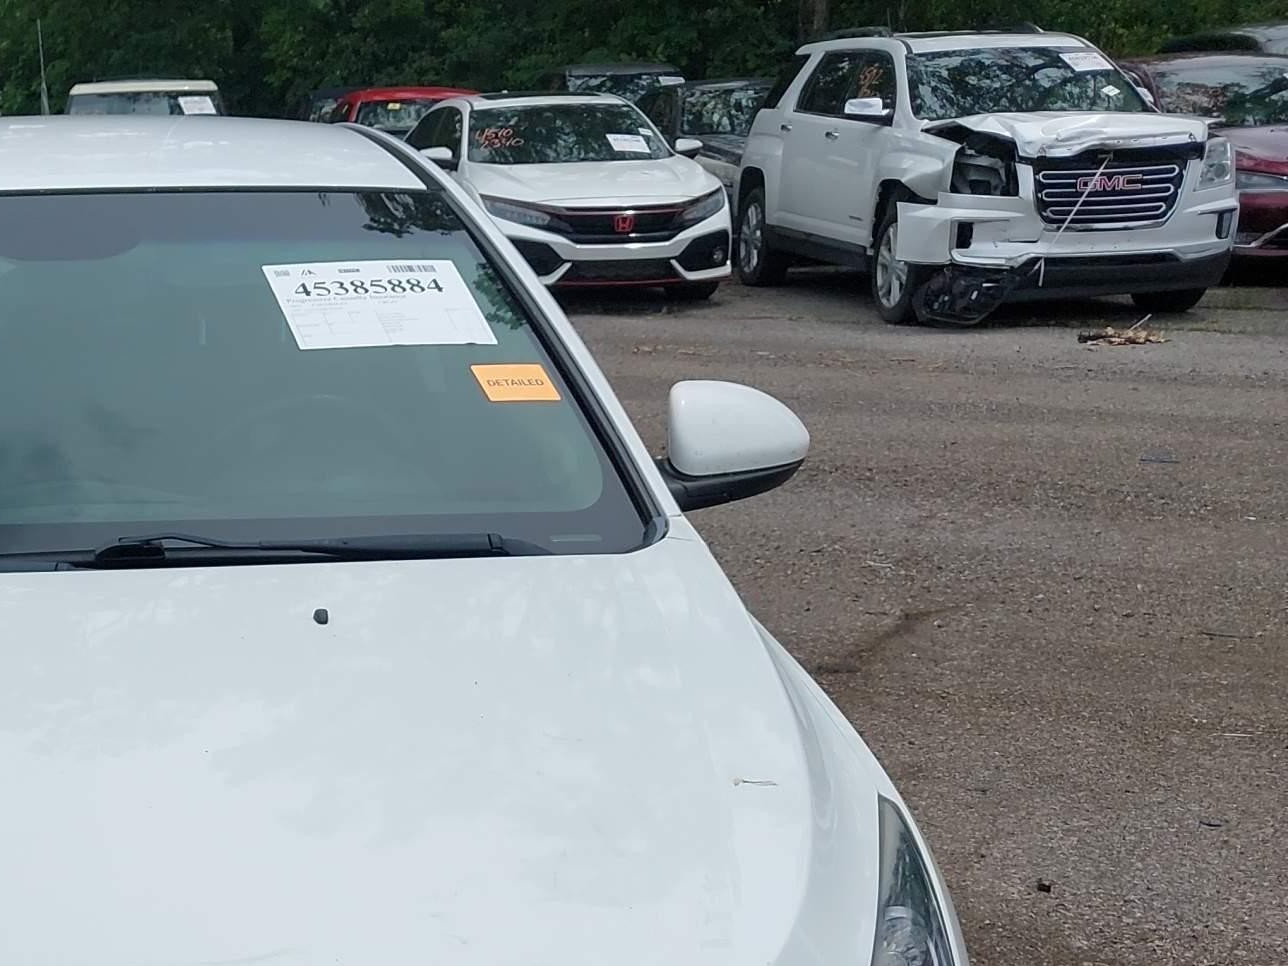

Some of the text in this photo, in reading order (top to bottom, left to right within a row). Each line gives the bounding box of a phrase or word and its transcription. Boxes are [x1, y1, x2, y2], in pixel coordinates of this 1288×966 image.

[1077, 174, 1143, 192] GMC
[294, 278, 444, 297] 45385884
[486, 378, 545, 387] DETAILED
